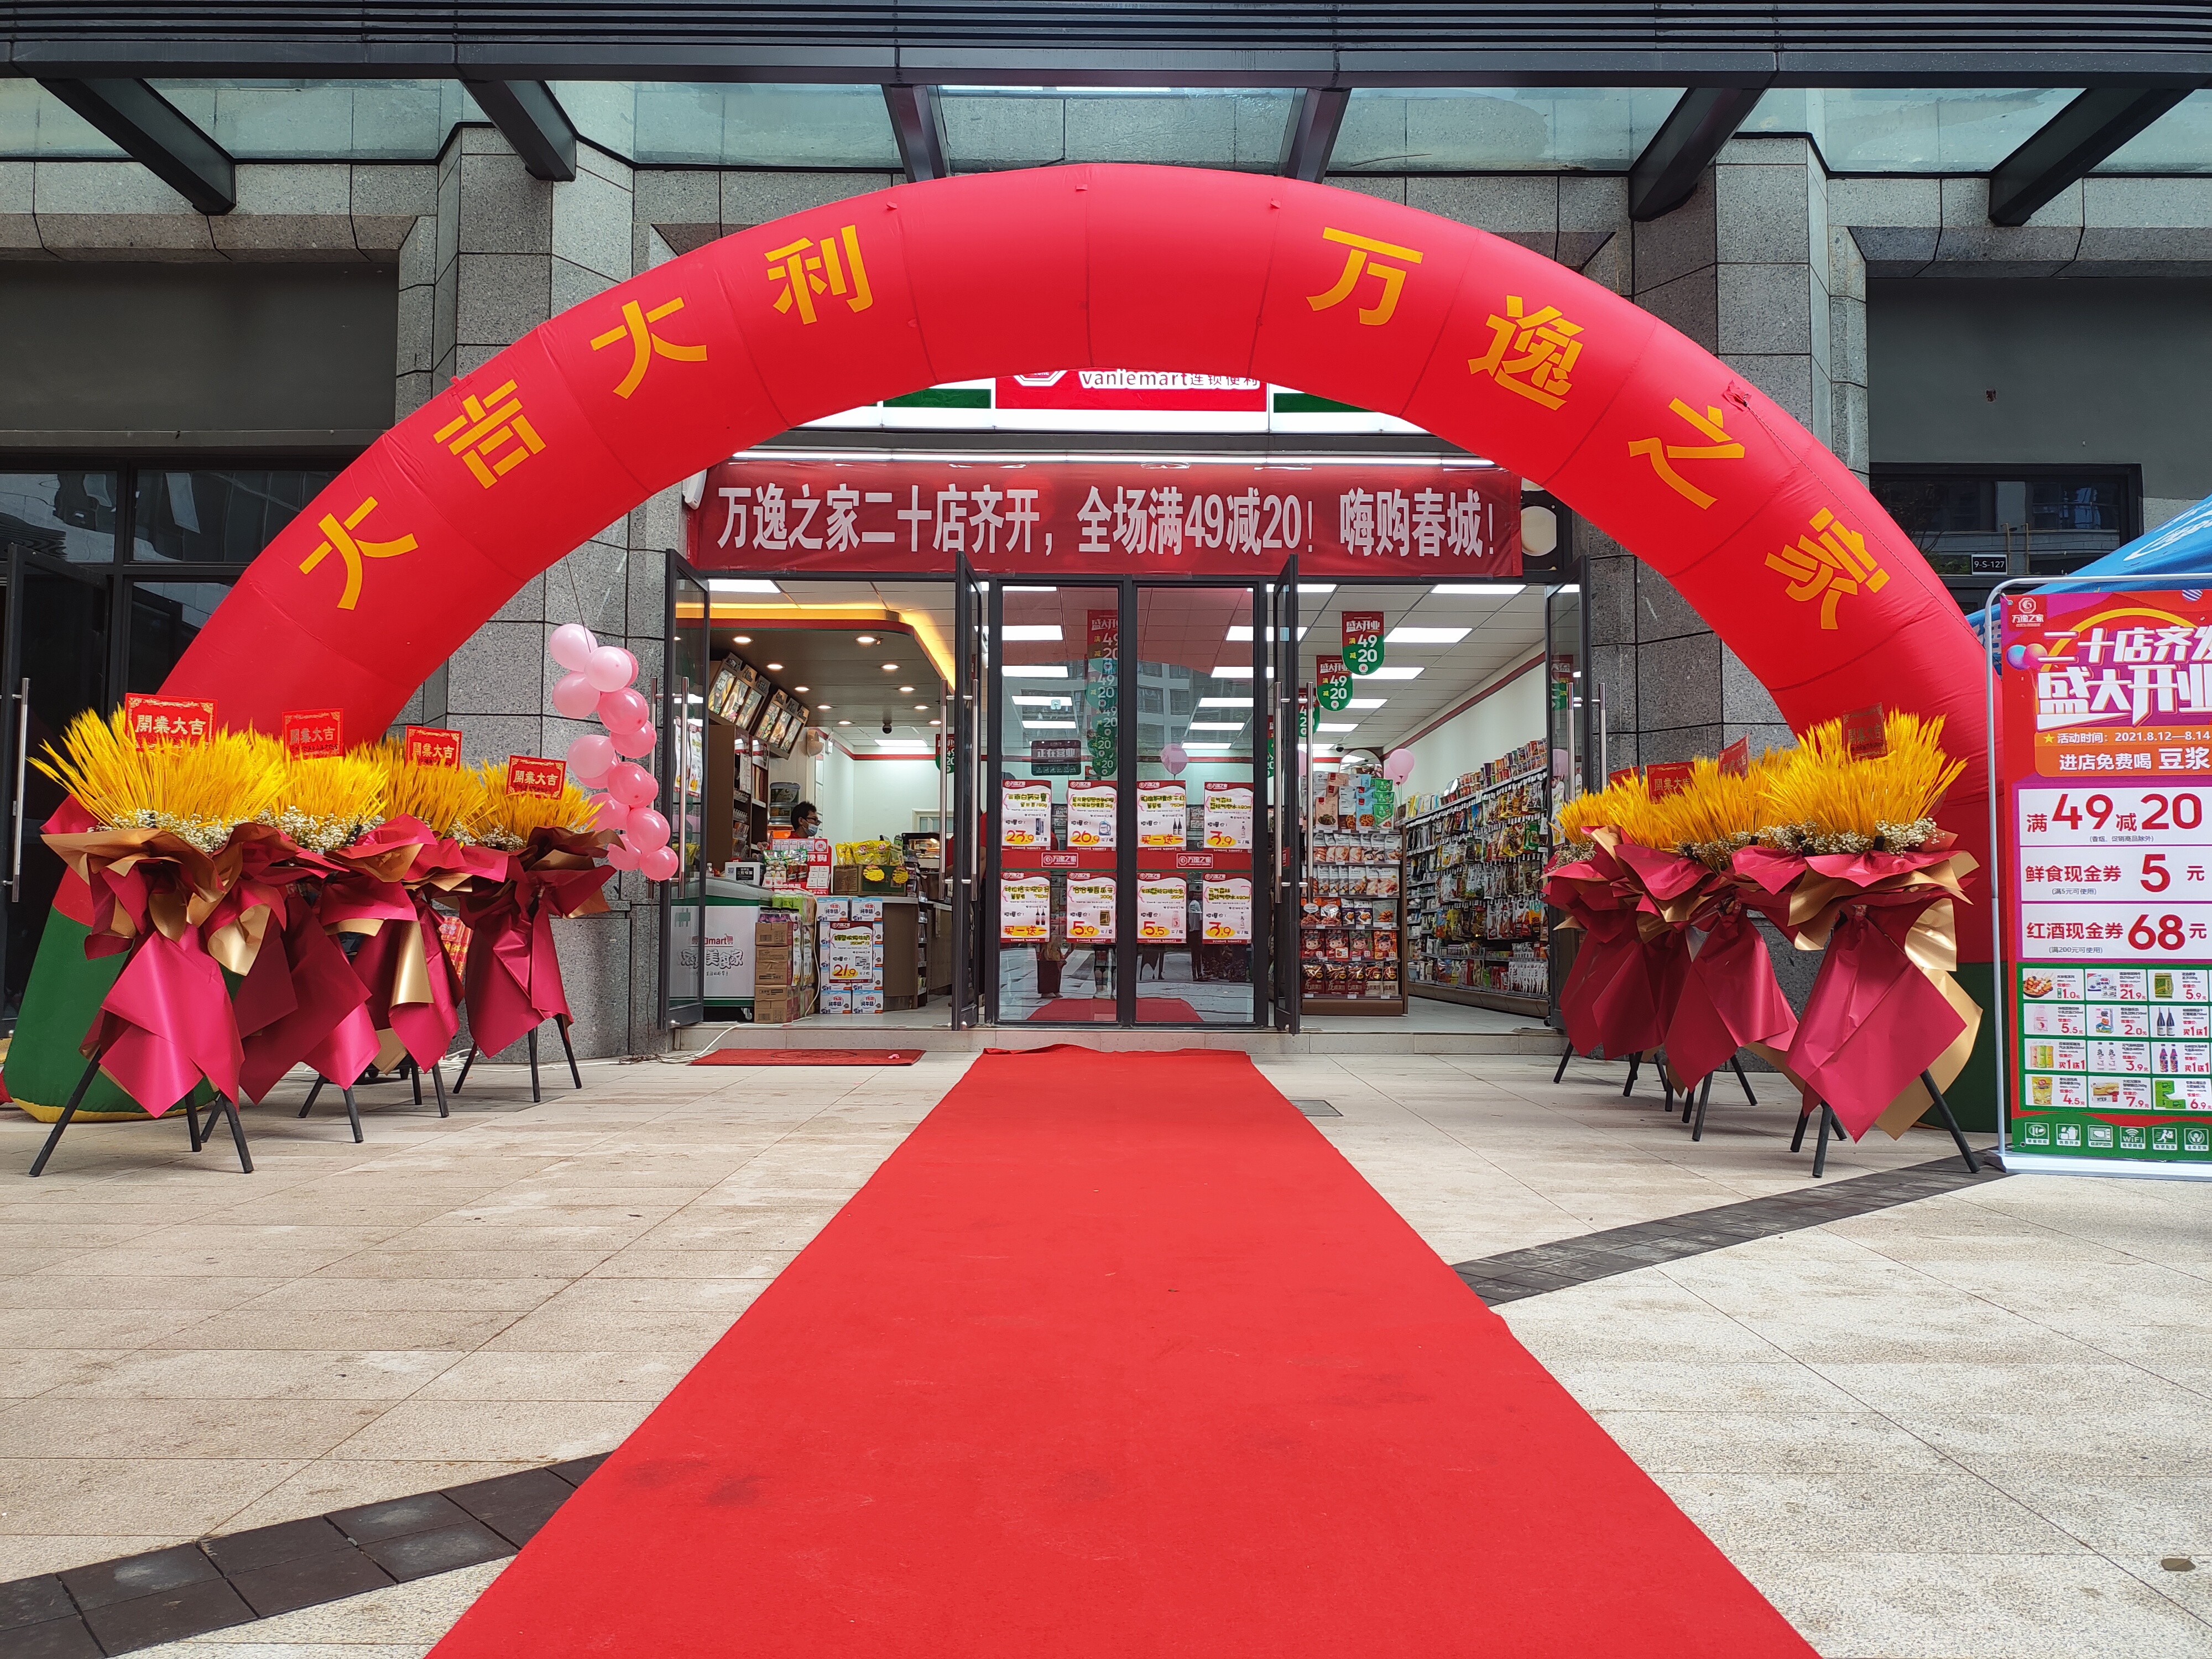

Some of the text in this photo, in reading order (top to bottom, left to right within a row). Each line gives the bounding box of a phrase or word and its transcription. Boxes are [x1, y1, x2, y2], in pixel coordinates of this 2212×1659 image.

[1305, 226, 1890, 630] 万逸之家
[717, 482, 1495, 558] 万逸之家二十店齐开， 全场满49减20！ 嗨购春城！
[1974, 560, 2005, 569] 9-S-127
[1091, 618, 1118, 631] 盛大开
[1345, 620, 1380, 633] 盛大开业
[2036, 663, 2212, 731] 盛大开业
[134, 714, 206, 736] 開業大吉
[290, 726, 336, 744] 開業大吉
[2057, 732, 2109, 744] 活动时间：
[412, 741, 455, 759] 開業大吉
[1036, 748, 1076, 758] 正在营业
[2059, 746, 2211, 771] 进店免费喝 豆浆
[513, 770, 559, 786] 開業大吉
[1006, 830, 1035, 843] 23.9
[1072, 830, 1100, 843] 26.9
[1141, 833, 1184, 845] 买一送一
[1210, 830, 1233, 846] 3.9
[2025, 853, 2205, 893] 鲜食现金券 5 元
[1004, 925, 1047, 936] 买一送一
[1073, 921, 1095, 935] 5.9
[1143, 921, 1165, 936] 5.5
[1208, 921, 1232, 936] 3.9
[2026, 922, 2124, 940] 红酒现金券
[2122, 1135, 2143, 1143] WiFi
